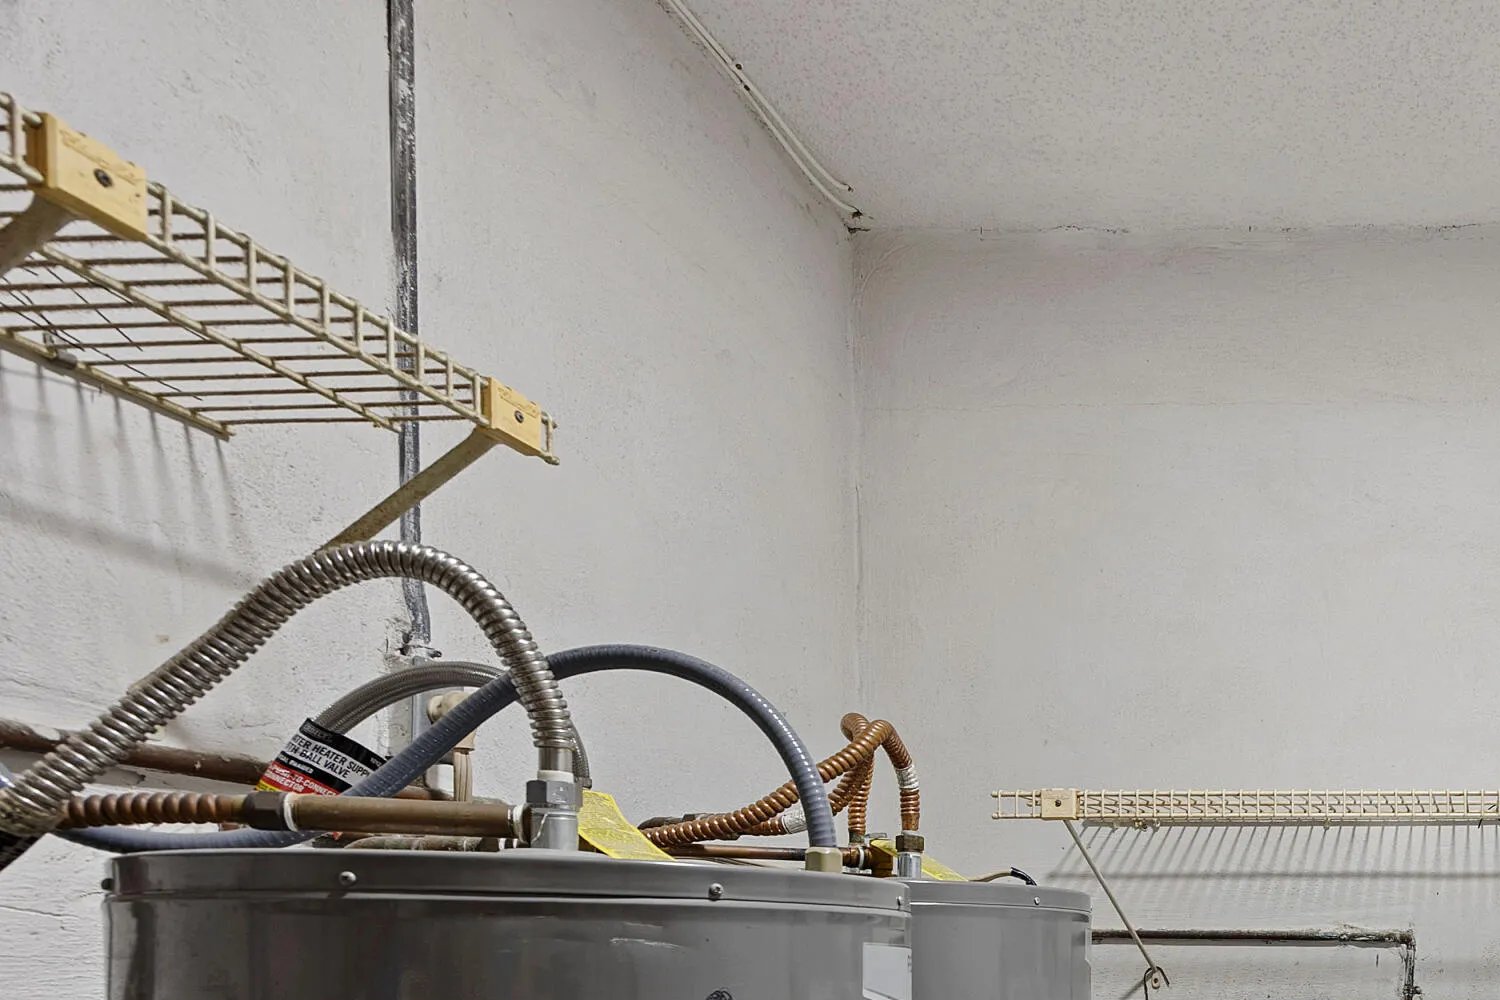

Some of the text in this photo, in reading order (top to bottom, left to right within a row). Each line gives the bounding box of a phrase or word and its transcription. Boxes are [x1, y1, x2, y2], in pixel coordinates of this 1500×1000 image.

[300, 749, 322, 766] BALL
[323, 759, 351, 779] VALVE
[312, 743, 347, 767] HEATER
[347, 760, 371, 778] SUPP
